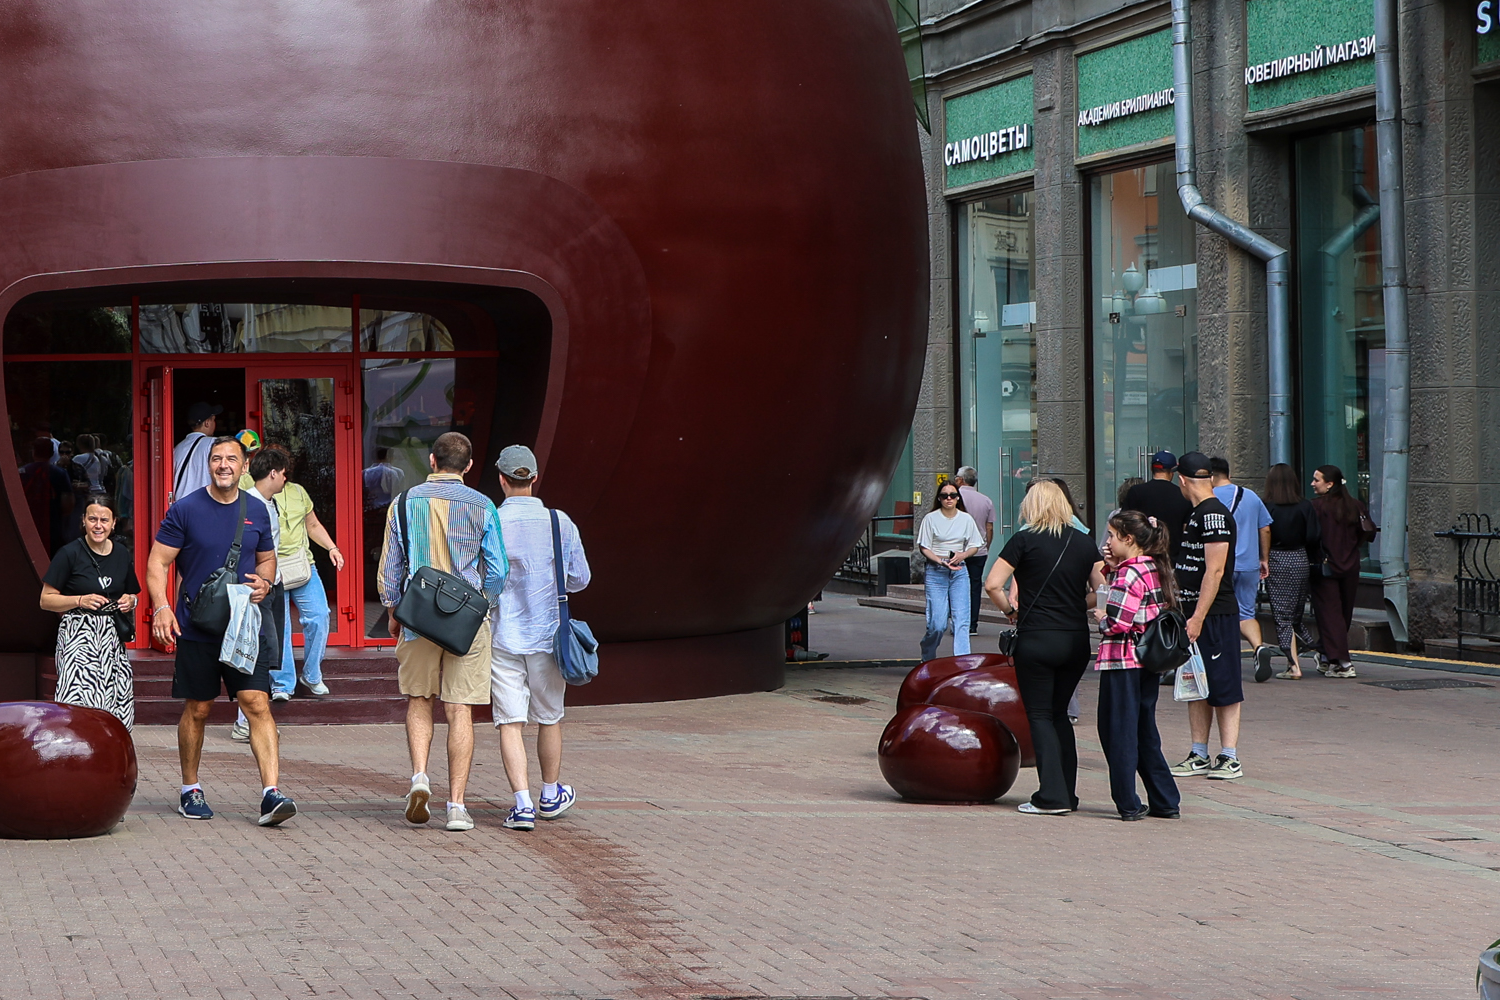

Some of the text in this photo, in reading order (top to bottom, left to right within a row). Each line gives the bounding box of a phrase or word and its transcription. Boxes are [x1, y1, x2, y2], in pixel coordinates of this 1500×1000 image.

[1244, 34, 1376, 85] ЮВЕЛИРНЫЙ МАГАЗИ
[1077, 87, 1175, 127] АКАДЕМИЯ БРИЛЛИАНТО
[944, 123, 1027, 167] САМОЦВЕТЫ
